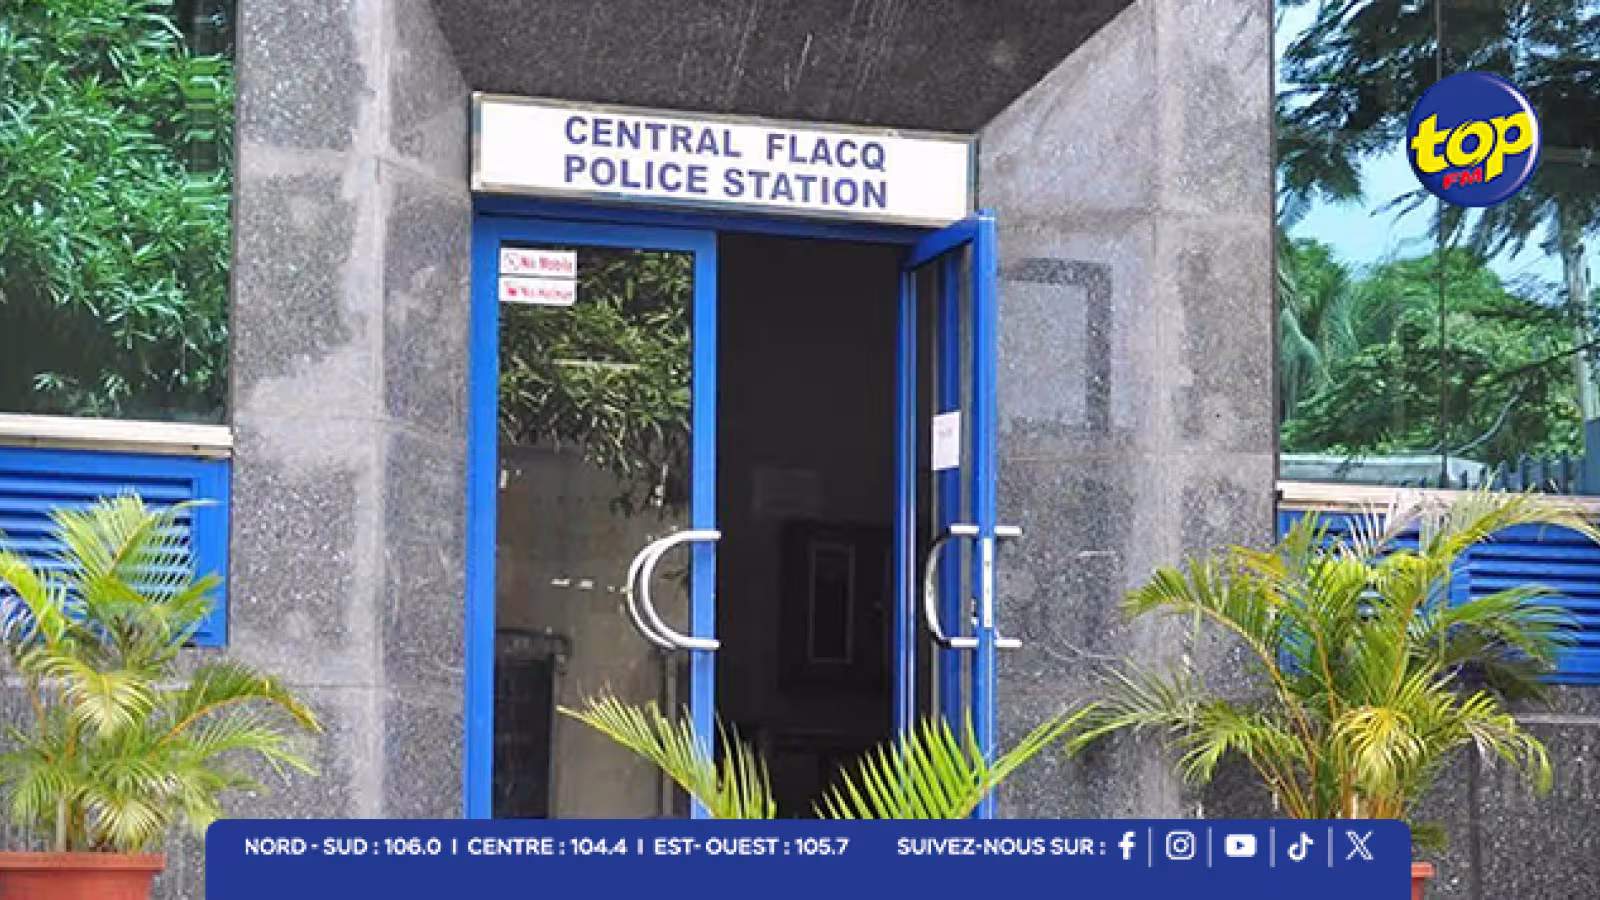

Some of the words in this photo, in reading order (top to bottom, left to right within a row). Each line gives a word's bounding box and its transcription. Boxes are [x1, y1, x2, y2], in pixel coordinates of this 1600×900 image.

[564, 115, 742, 158] CENTRAL
[766, 133, 886, 173] FLACQ
[564, 154, 708, 194] POLICE
[723, 168, 888, 209] STATION
